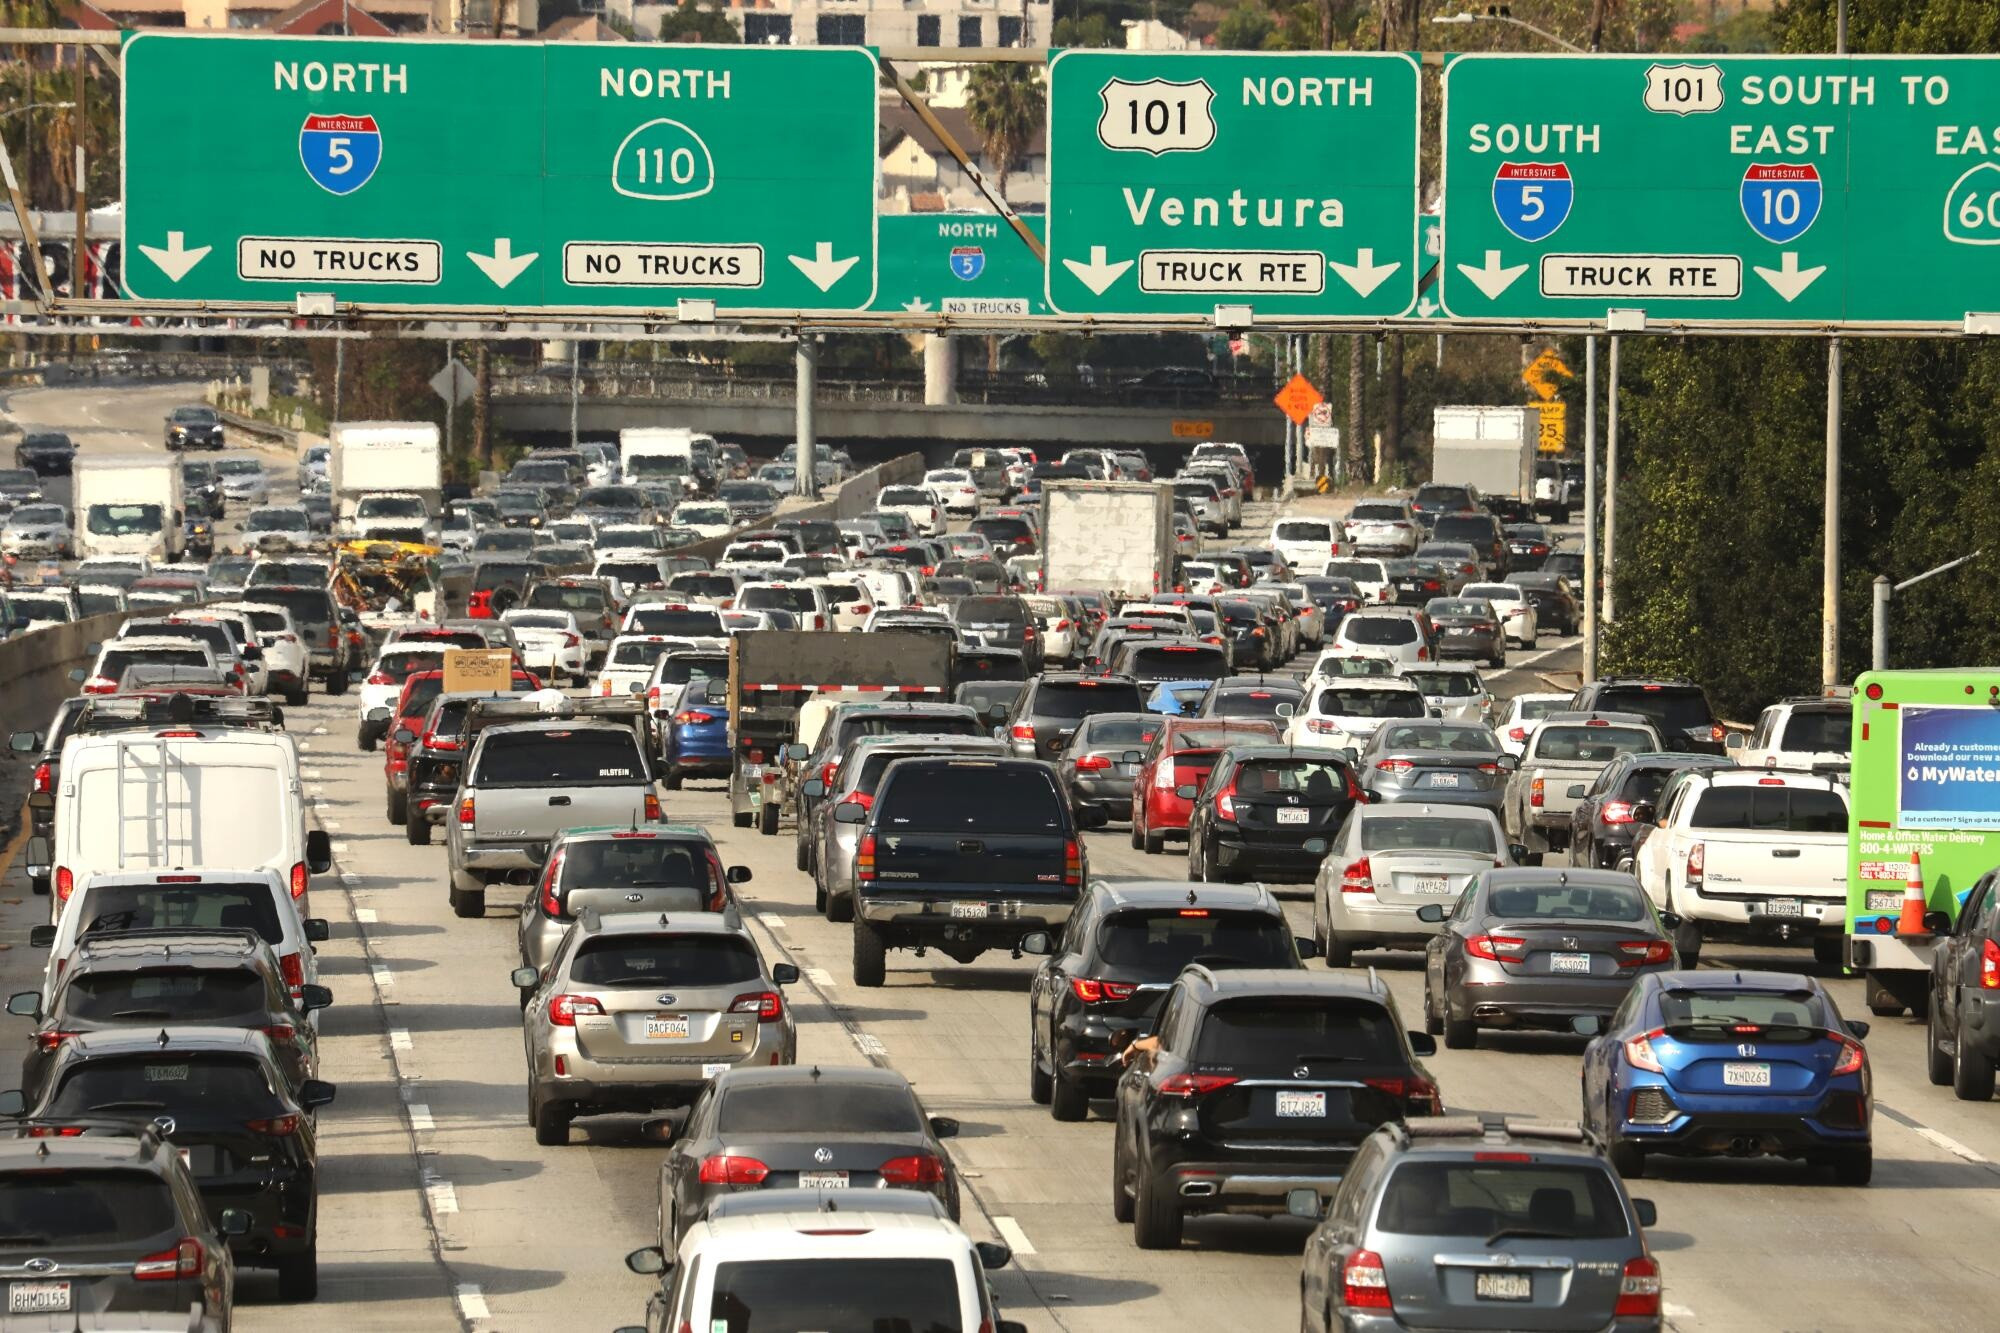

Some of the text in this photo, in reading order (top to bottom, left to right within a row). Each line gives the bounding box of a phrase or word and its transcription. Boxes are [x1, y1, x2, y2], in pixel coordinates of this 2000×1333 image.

[274, 61, 408, 94] NORTH
[600, 67, 731, 99] NORTH
[1242, 76, 1372, 107] NORTH
[1663, 75, 1950, 106] 101 SOUTH TO
[317, 120, 364, 130] INTERSTATE
[1128, 99, 1186, 136] 101
[1469, 123, 1600, 154] SOUTH
[1731, 124, 1835, 155] EAST
[328, 137, 354, 175] 5
[636, 147, 695, 184] 110
[1510, 168, 1557, 177] INTERSTATE
[1759, 169, 1805, 179] INTERSTATE
[1121, 187, 1344, 228] Ventura
[1520, 185, 1545, 222] 5
[1762, 188, 1800, 225] 10
[938, 222, 998, 238] NORTH
[260, 249, 419, 272] NO TRUCKS
[586, 254, 741, 275] NO TRUCKS
[962, 258, 974, 275] 5
[1156, 262, 1307, 282] TRUCK RTE
[1566, 266, 1717, 287] TRUCK RTE
[948, 303, 1022, 313] NO TRUCKS
[1541, 406, 1560, 414] AMP
[1907, 753, 1954, 761] Download
[1915, 743, 1950, 752] Already
[600, 768, 630, 776] BILSTEIN
[1860, 830, 1985, 845] Home & Office Water Delivery
[1860, 842, 1934, 855] 800-4-WATERS
[626, 893, 642, 901] KIA
[648, 1023, 686, 1034] 8ACF064
[1280, 1100, 1322, 1113] 8TZJ824
